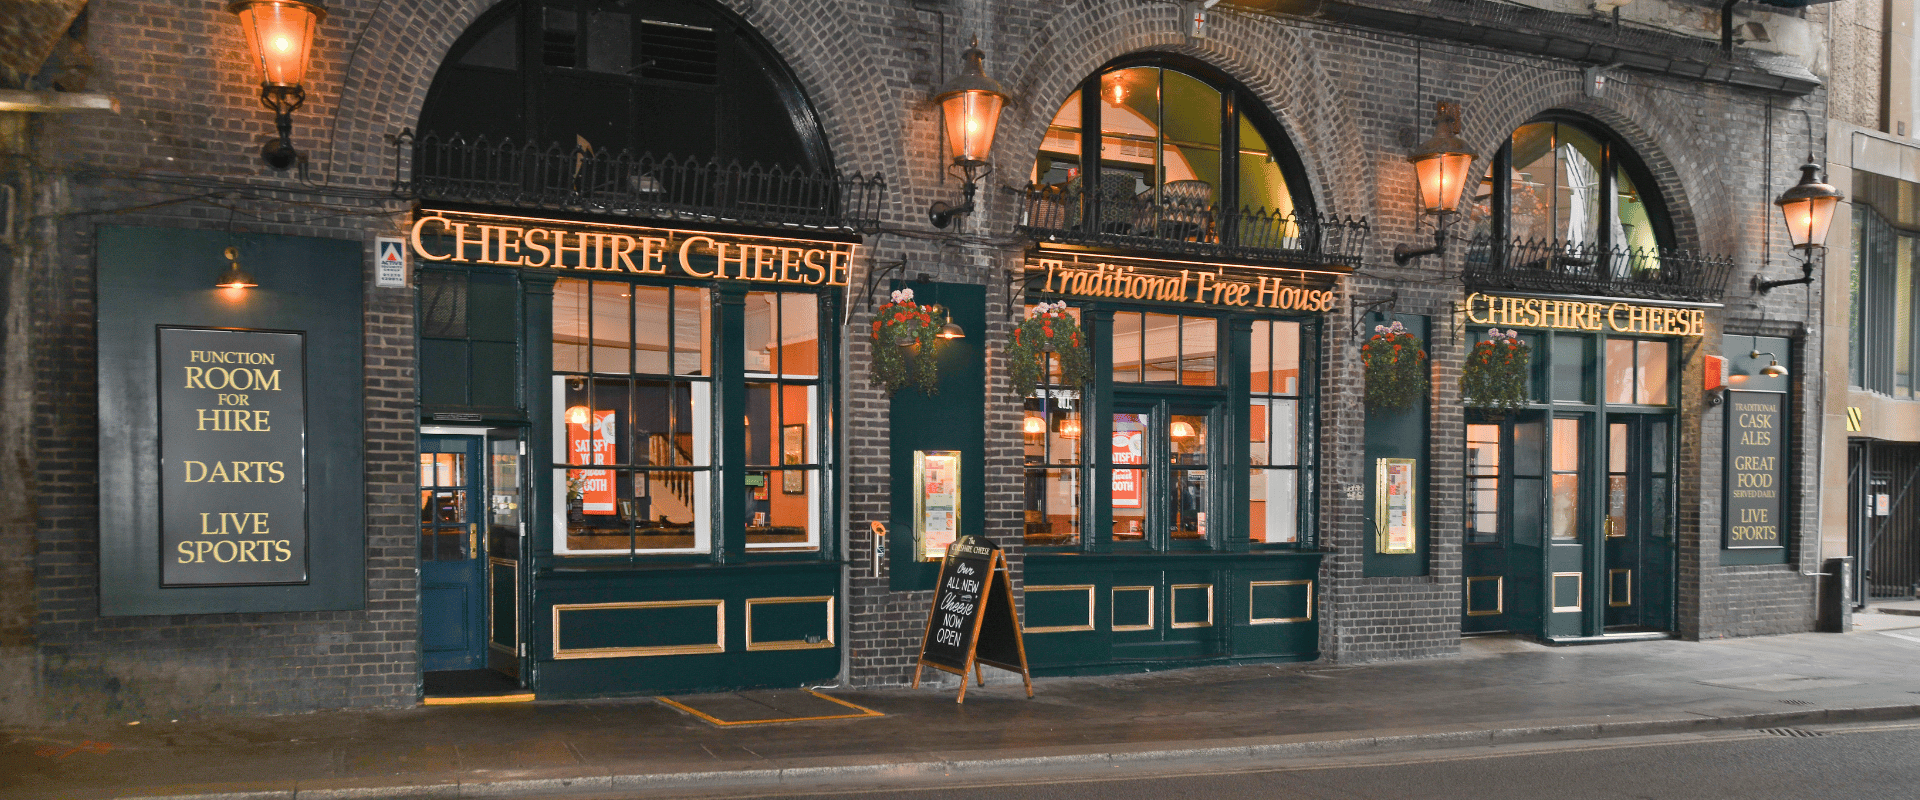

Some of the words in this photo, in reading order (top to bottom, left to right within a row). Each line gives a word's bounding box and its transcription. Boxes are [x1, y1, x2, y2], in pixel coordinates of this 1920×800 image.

[411, 216, 666, 275] CHESHIRE
[679, 236, 851, 287] CHEESE
[1039, 258, 1189, 303] Traditional
[1193, 271, 1250, 307] Free
[1254, 276, 1334, 312] House
[1466, 292, 1603, 331] CHESHIRE
[1607, 302, 1705, 336] CHEESE
[190, 350, 275, 365] FUNCTION
[184, 366, 281, 391] ROOM
[218, 393, 249, 406] FOR
[1735, 403, 1777, 412] TRADITIONAL
[196, 409, 270, 432] HIRE
[1739, 413, 1772, 428] CASK
[575, 439, 608, 452] SATSFY
[1740, 431, 1771, 445] ALES
[1112, 452, 1135, 462] TISFY
[1735, 456, 1776, 471] GREAT
[183, 460, 285, 484] DARTS
[1112, 481, 1134, 491] OOTH
[1738, 473, 1773, 488] FOOD
[1733, 490, 1757, 498] SERVED
[1757, 490, 1776, 498] DAILY
[1741, 508, 1768, 523] LIVE
[200, 512, 270, 535] LIVE
[1732, 525, 1777, 540] SPORTS
[177, 539, 292, 564] SPORTS
[946, 576, 960, 590] ALL
[961, 579, 980, 593] NEW
[943, 613, 964, 629] NOW
[936, 628, 962, 647] OPEN
